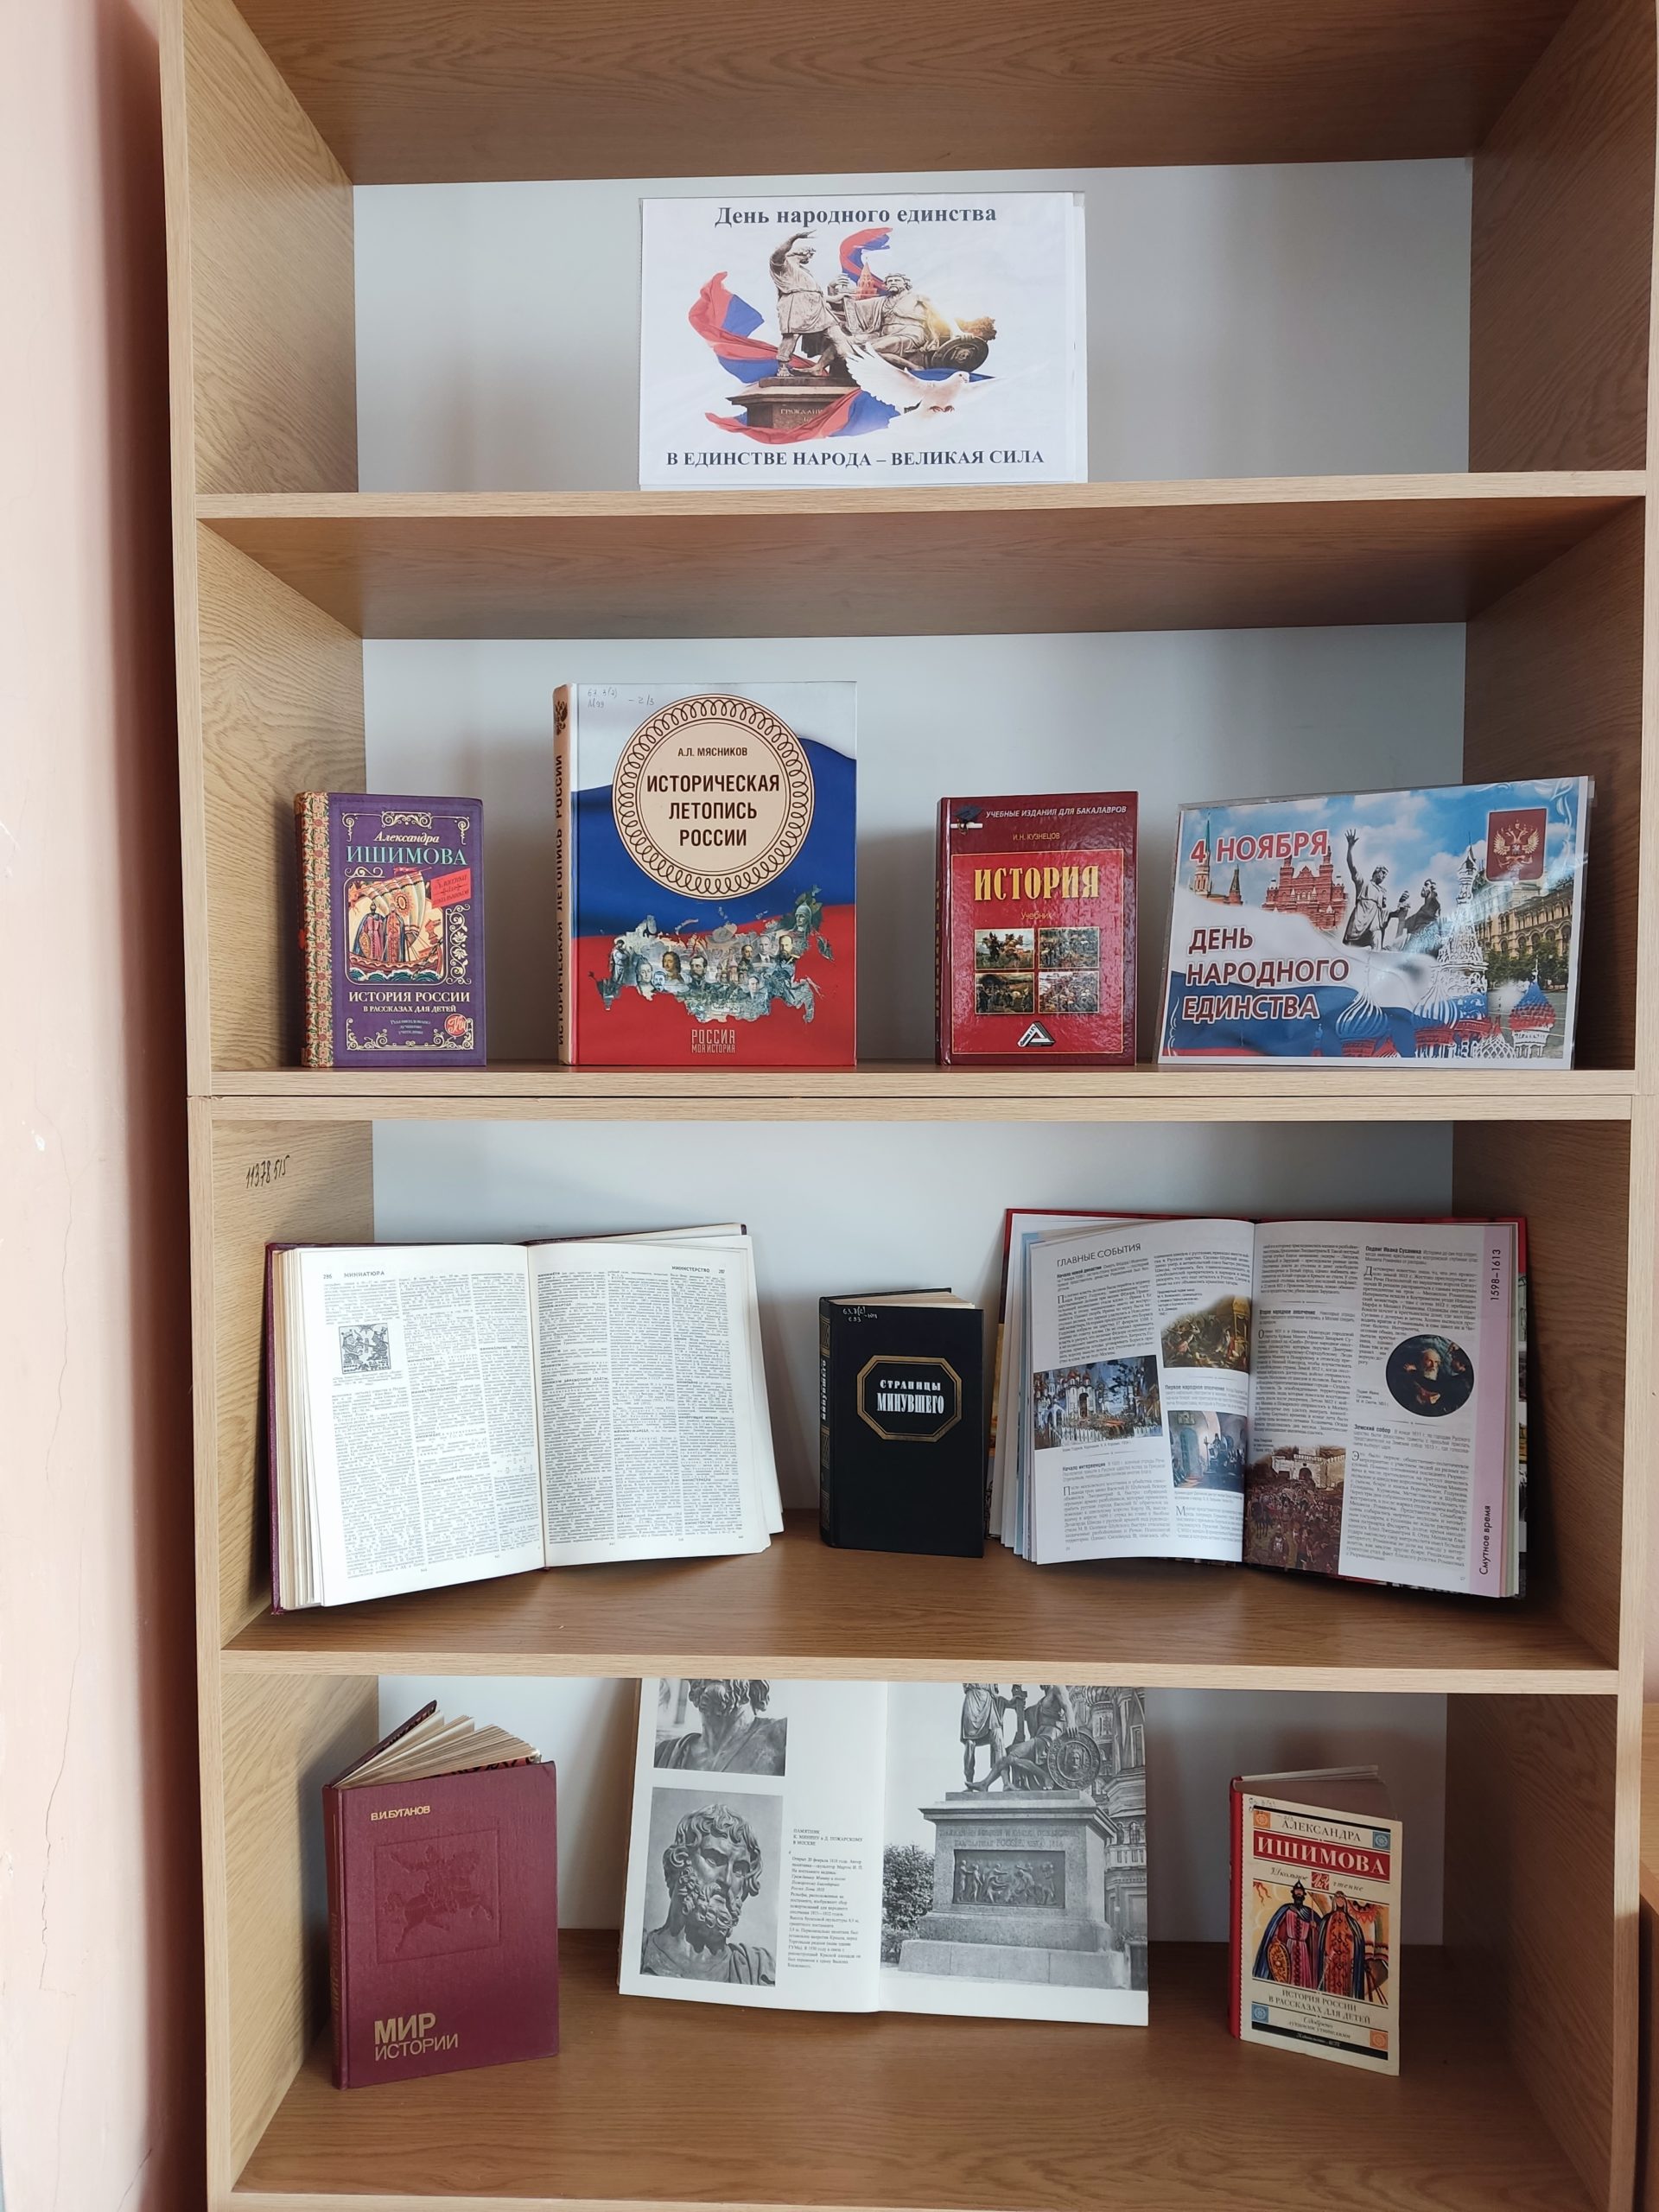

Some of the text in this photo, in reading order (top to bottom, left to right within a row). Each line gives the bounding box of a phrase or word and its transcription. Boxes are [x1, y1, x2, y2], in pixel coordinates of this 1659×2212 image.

[715, 207, 996, 228] День народного единства
[666, 451, 679, 466] В
[683, 451, 787, 467] ЕДИНСТВЕ
[793, 451, 871, 468] НАРОДА
[891, 450, 984, 467] ВЕЛИКАЯ
[989, 449, 1044, 465] СИЛА
[677, 747, 748, 757] А.Л. МЯСНИКОВ
[646, 774, 779, 793] ИСТОРИЧЕСКАЯ
[669, 802, 757, 820] ЛЕТОПИСЬ
[986, 805, 1127, 819] УЧЕБНЫЕ ИЗДАНИЯ ДЛЯ БАКАЛАВРОВ
[372, 831, 440, 844] Александра
[679, 829, 747, 847] РОССИИ
[1027, 832, 1061, 841] КУЗНЕЦОВ
[1190, 830, 1329, 864] 4 НОЯБРЯ
[346, 845, 467, 866] ИШИМОВА
[556, 828, 564, 912] ЛЕТОПИСЬ
[974, 864, 1100, 901] ИСТОРИЯ
[1020, 911, 1052, 921] Учебник
[1187, 927, 1254, 955] ДЕНЬ
[1186, 958, 1349, 988] НАРОДНОГО
[348, 991, 471, 1002] ИСТОРИЯ РОССИИ
[1182, 994, 1320, 1023] ЕДИНСТВА
[691, 1028, 735, 1044] РОССИЯ
[691, 1044, 735, 1053] МОЯ ИСТОРИЯ
[1057, 1243, 1141, 1268] ГЛАВНЫЕ СОБЫТИЯ
[1490, 1249, 1501, 1300] 1598–1613
[880, 1380, 941, 1391] СТРАНИЦЫ
[877, 1393, 944, 1414] МИНУВШЕГО
[1478, 1505, 1493, 1575] Смутное время
[1281, 1819, 1362, 1842] АЛЕКСАНДРА
[1257, 1835, 1386, 1876] ИШИМОВА
[1275, 1997, 1322, 2014] РАССКАЗАХ
[1324, 2008, 1340, 2017] ДЛЯ
[1342, 2012, 1370, 2024] ДЕТЕЙ
[1282, 1989, 1357, 2012] ИСТОРИЯ РОССИИ
[374, 2012, 435, 2045] МИР
[374, 2033, 459, 2062] ИСТОРИИ
